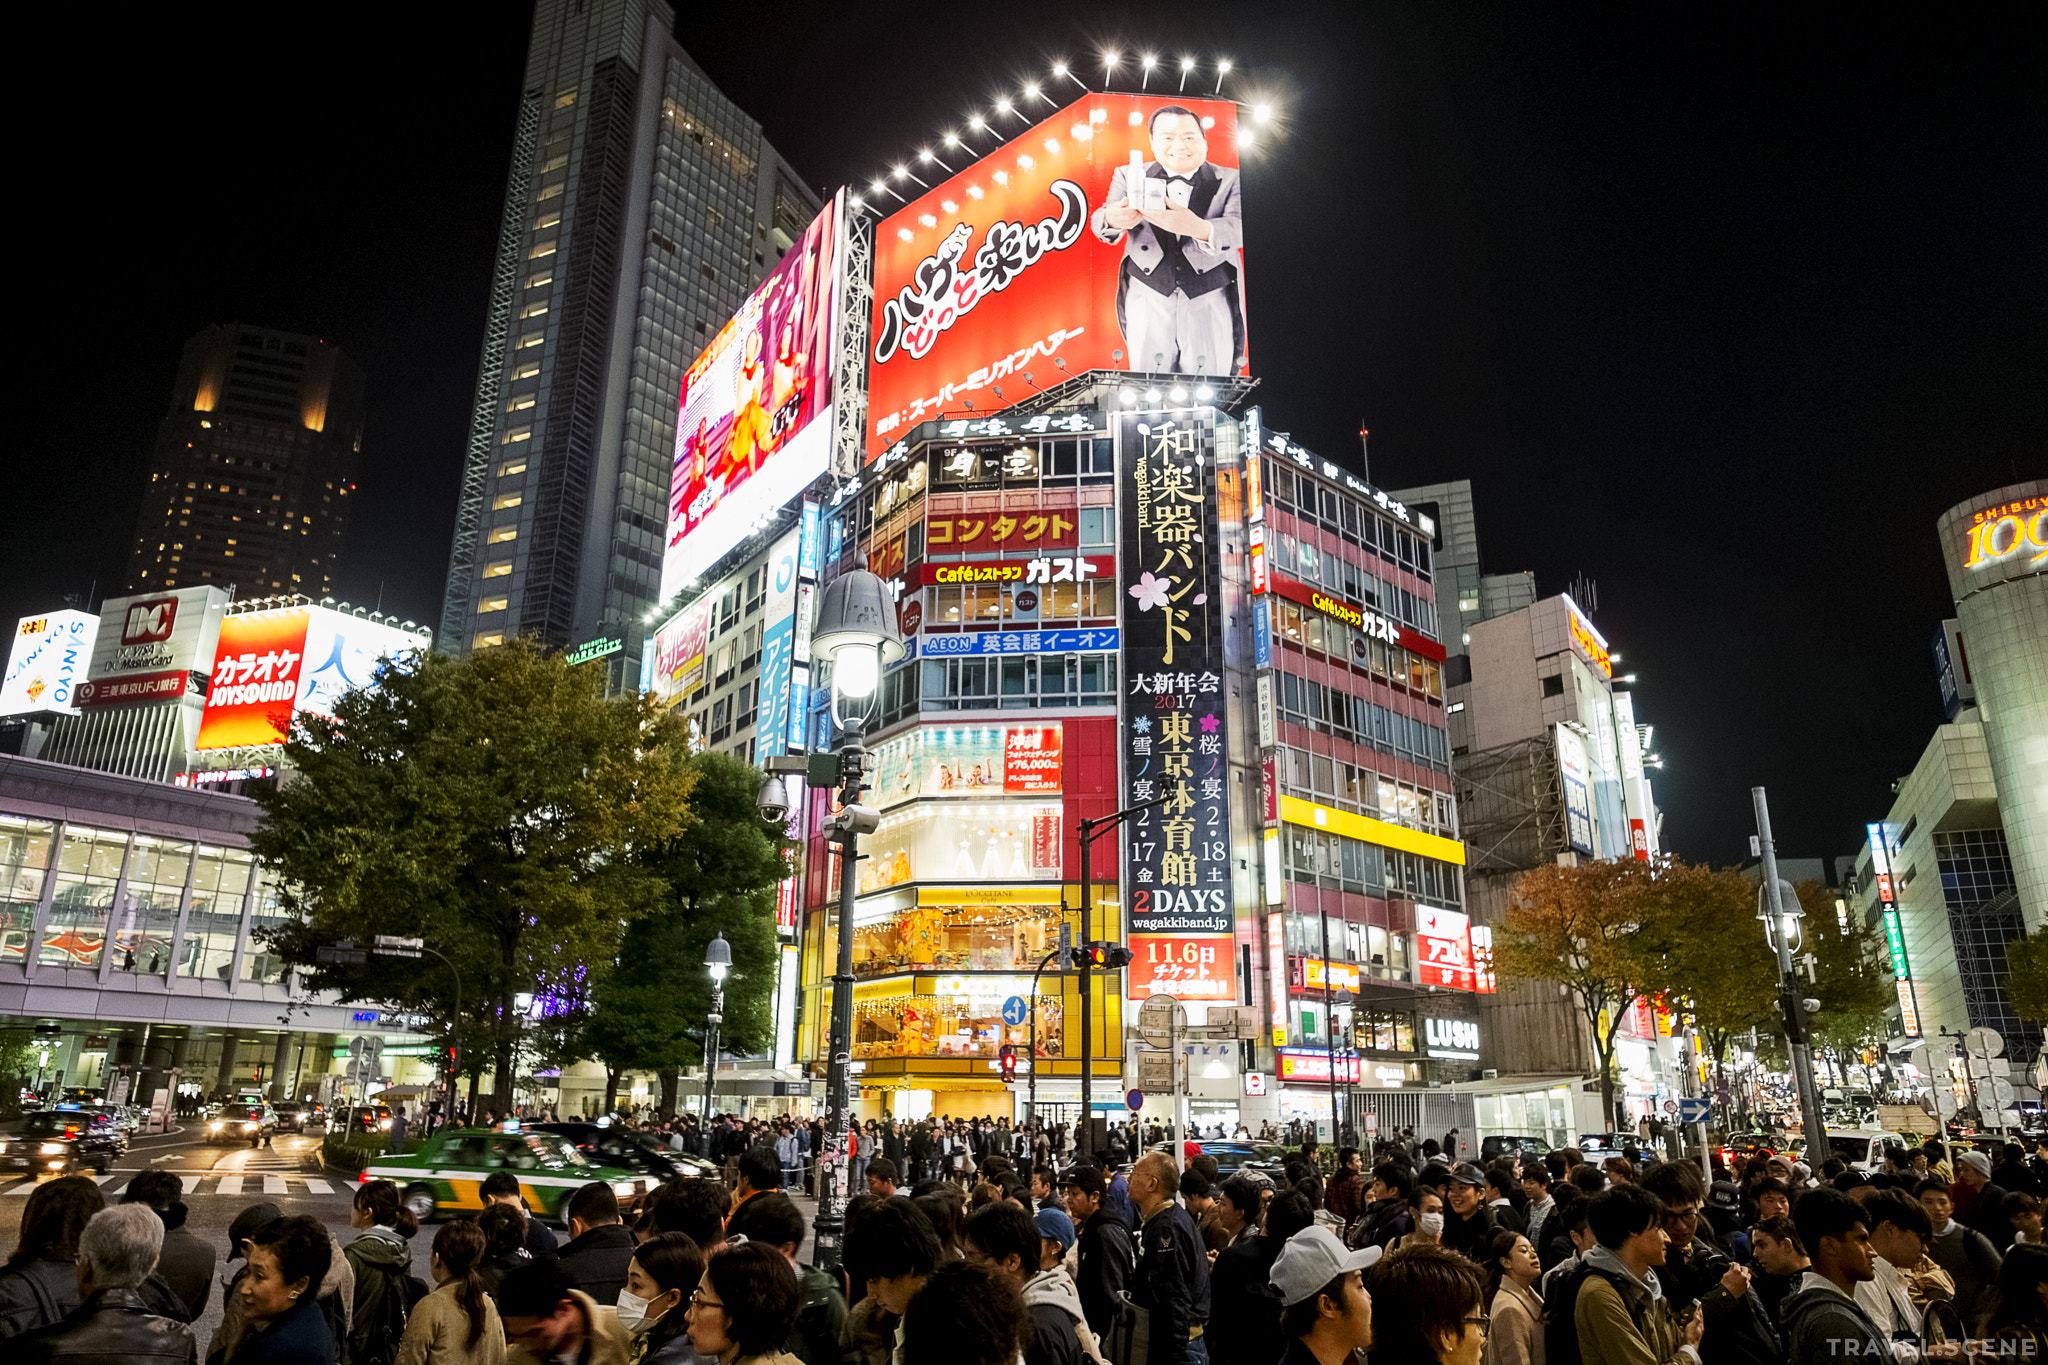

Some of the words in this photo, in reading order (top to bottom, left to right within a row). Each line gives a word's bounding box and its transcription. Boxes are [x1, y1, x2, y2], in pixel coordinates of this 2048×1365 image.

[928, 513, 1074, 543] コンタクト
[1151, 420, 1205, 665] 和楽器バンド
[935, 565, 1022, 583] Caféレストラン
[1025, 557, 1097, 585] ガスト
[1362, 611, 1400, 645] ガスト
[579, 636, 607, 651] SHIBUYA
[595, 638, 622, 654] CITY
[660, 629, 706, 679] クリニック
[928, 636, 972, 651] AEON
[54, 621, 86, 703] SANKYO
[213, 648, 301, 687] カラオケ
[100, 677, 180, 698] 三菱東京UFJ銀行
[207, 678, 297, 708] JOYSOUND
[1129, 671, 1220, 695] 大新年会
[1154, 694, 1197, 709] 2017
[1132, 736, 1154, 801] 雪ノ宴
[1199, 734, 1222, 800] 桜ノ宴
[1262, 755, 1274, 765] 5F
[1158, 711, 1198, 887] 東京体育館
[1137, 867, 1153, 883] 金
[1207, 867, 1223, 882] 土
[965, 889, 1014, 897] L'OCCITANE
[1133, 889, 1226, 913] 2DAYS
[1132, 916, 1228, 931] wagakkiband.jp
[1427, 938, 1463, 965] アコム
[1153, 963, 1210, 980] チケット
[1898, 986, 1917, 1032] HOOTERS
[1425, 1018, 1480, 1050] LUSH
